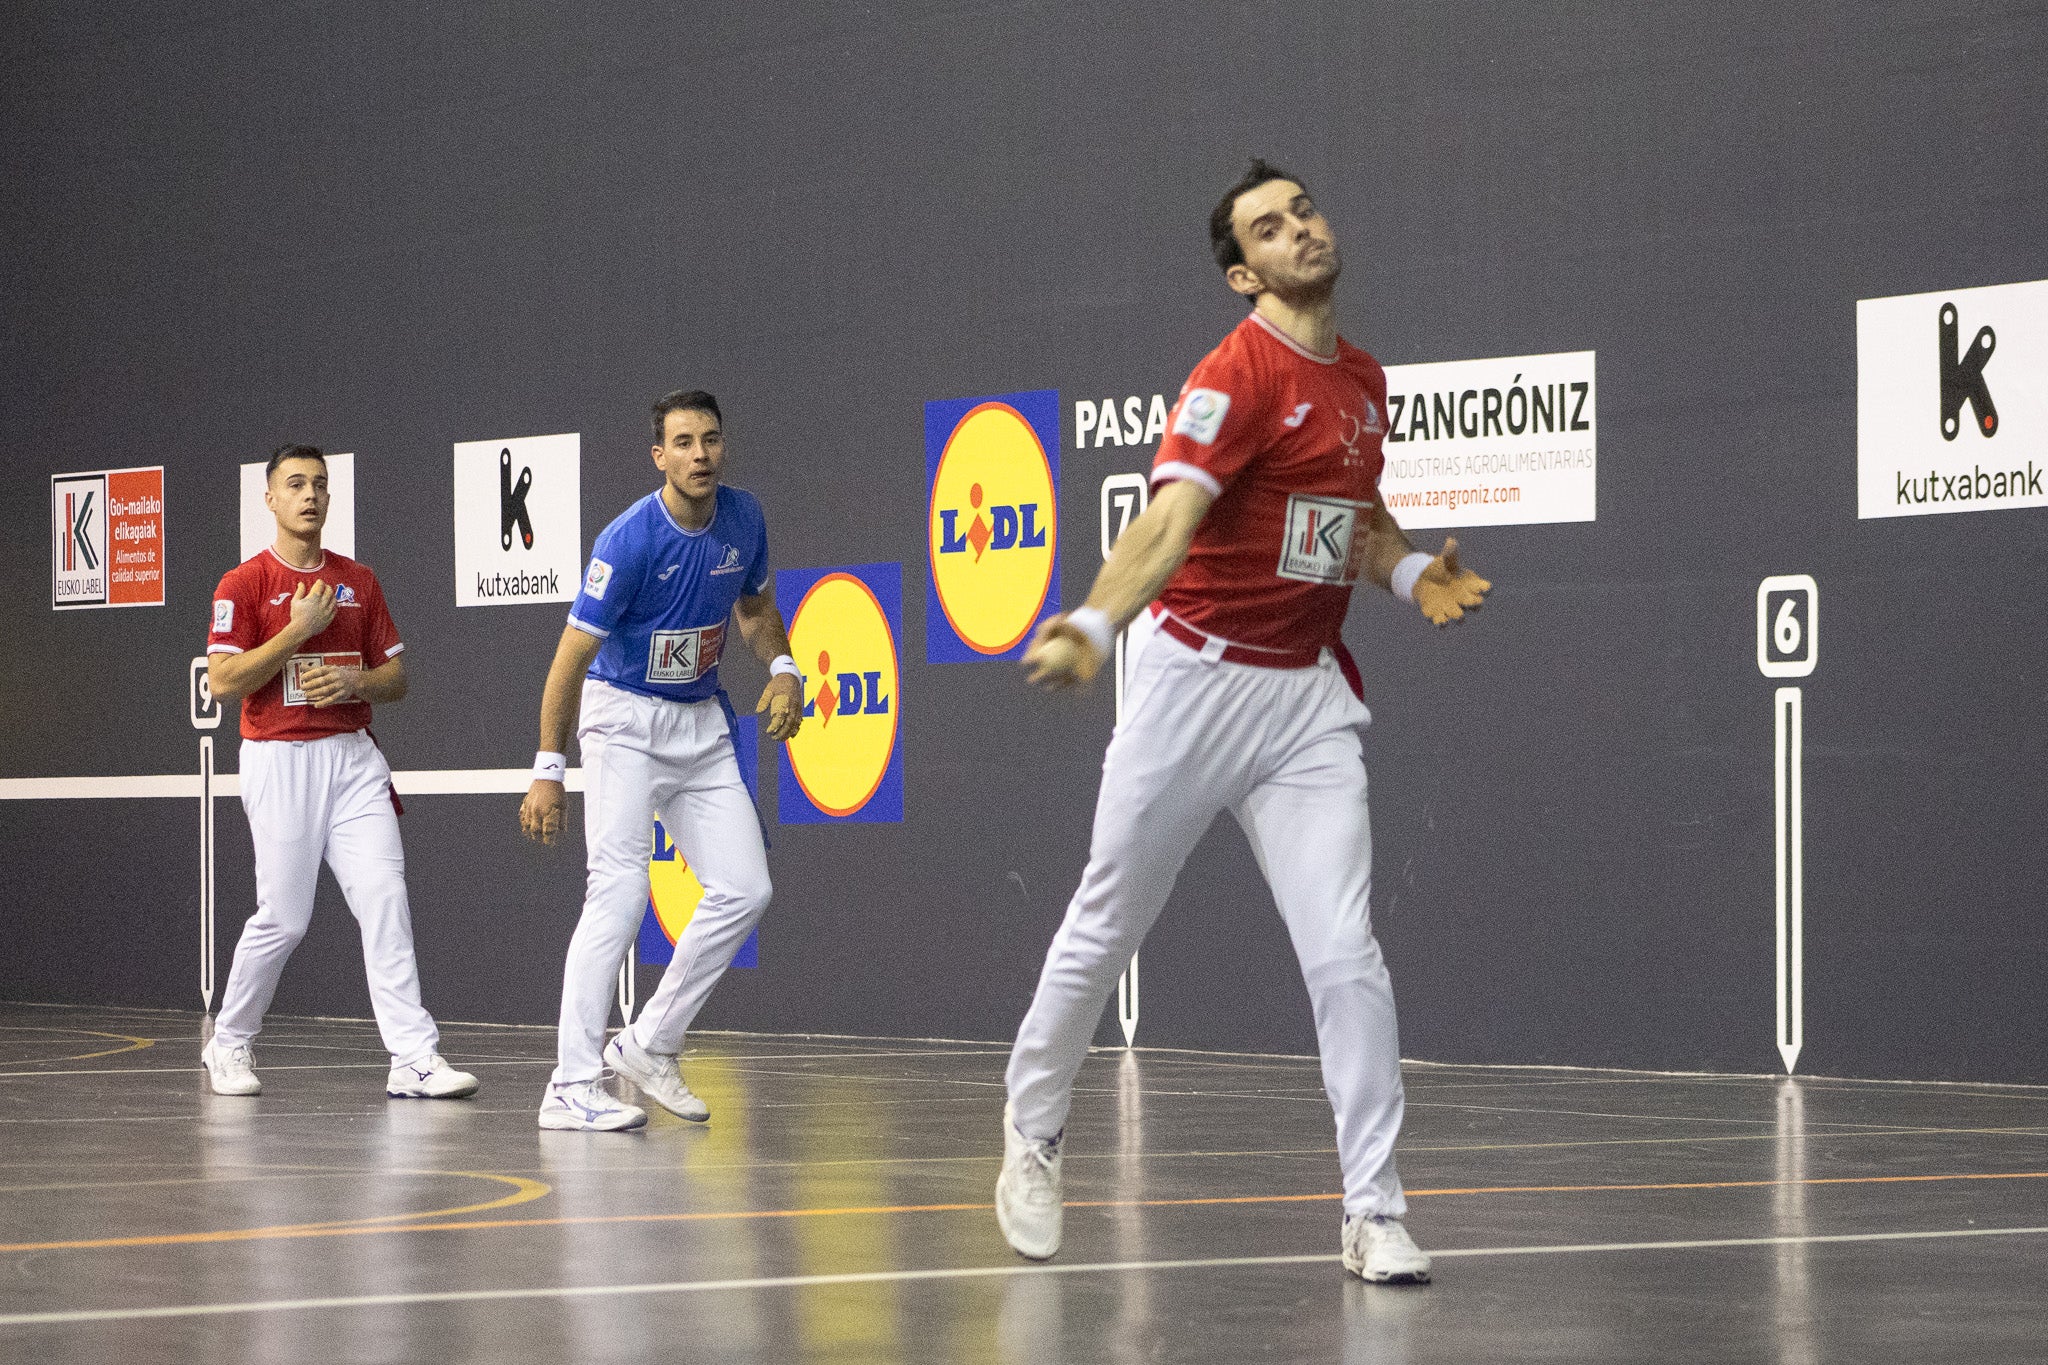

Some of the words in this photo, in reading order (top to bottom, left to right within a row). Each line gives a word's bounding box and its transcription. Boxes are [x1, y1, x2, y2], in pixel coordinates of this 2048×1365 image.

[1075, 394, 1167, 449] PASA
[1387, 373, 1590, 443] ZANGRÓNIZ
[1387, 456, 1460, 479] INDUSTRIAS
[1465, 448, 1593, 475] AGROALIMENTARIAS
[1387, 484, 1521, 510] www.zangroniz.com
[1896, 460, 2044, 505] kutxabank
[110, 495, 161, 516] Goi-mailako
[1114, 494, 1135, 541] 7
[114, 520, 157, 544] elikagaiak
[115, 549, 147, 564] Alimentos
[147, 548, 156, 562] de
[58, 579, 80, 596] EUSKO
[82, 578, 103, 594] LABEL
[111, 568, 134, 583] calidad
[134, 567, 160, 584] superior
[477, 568, 559, 598] kutxabank
[1774, 598, 1801, 654] 6
[199, 672, 213, 713] 9
[289, 692, 307, 700] EUSK
